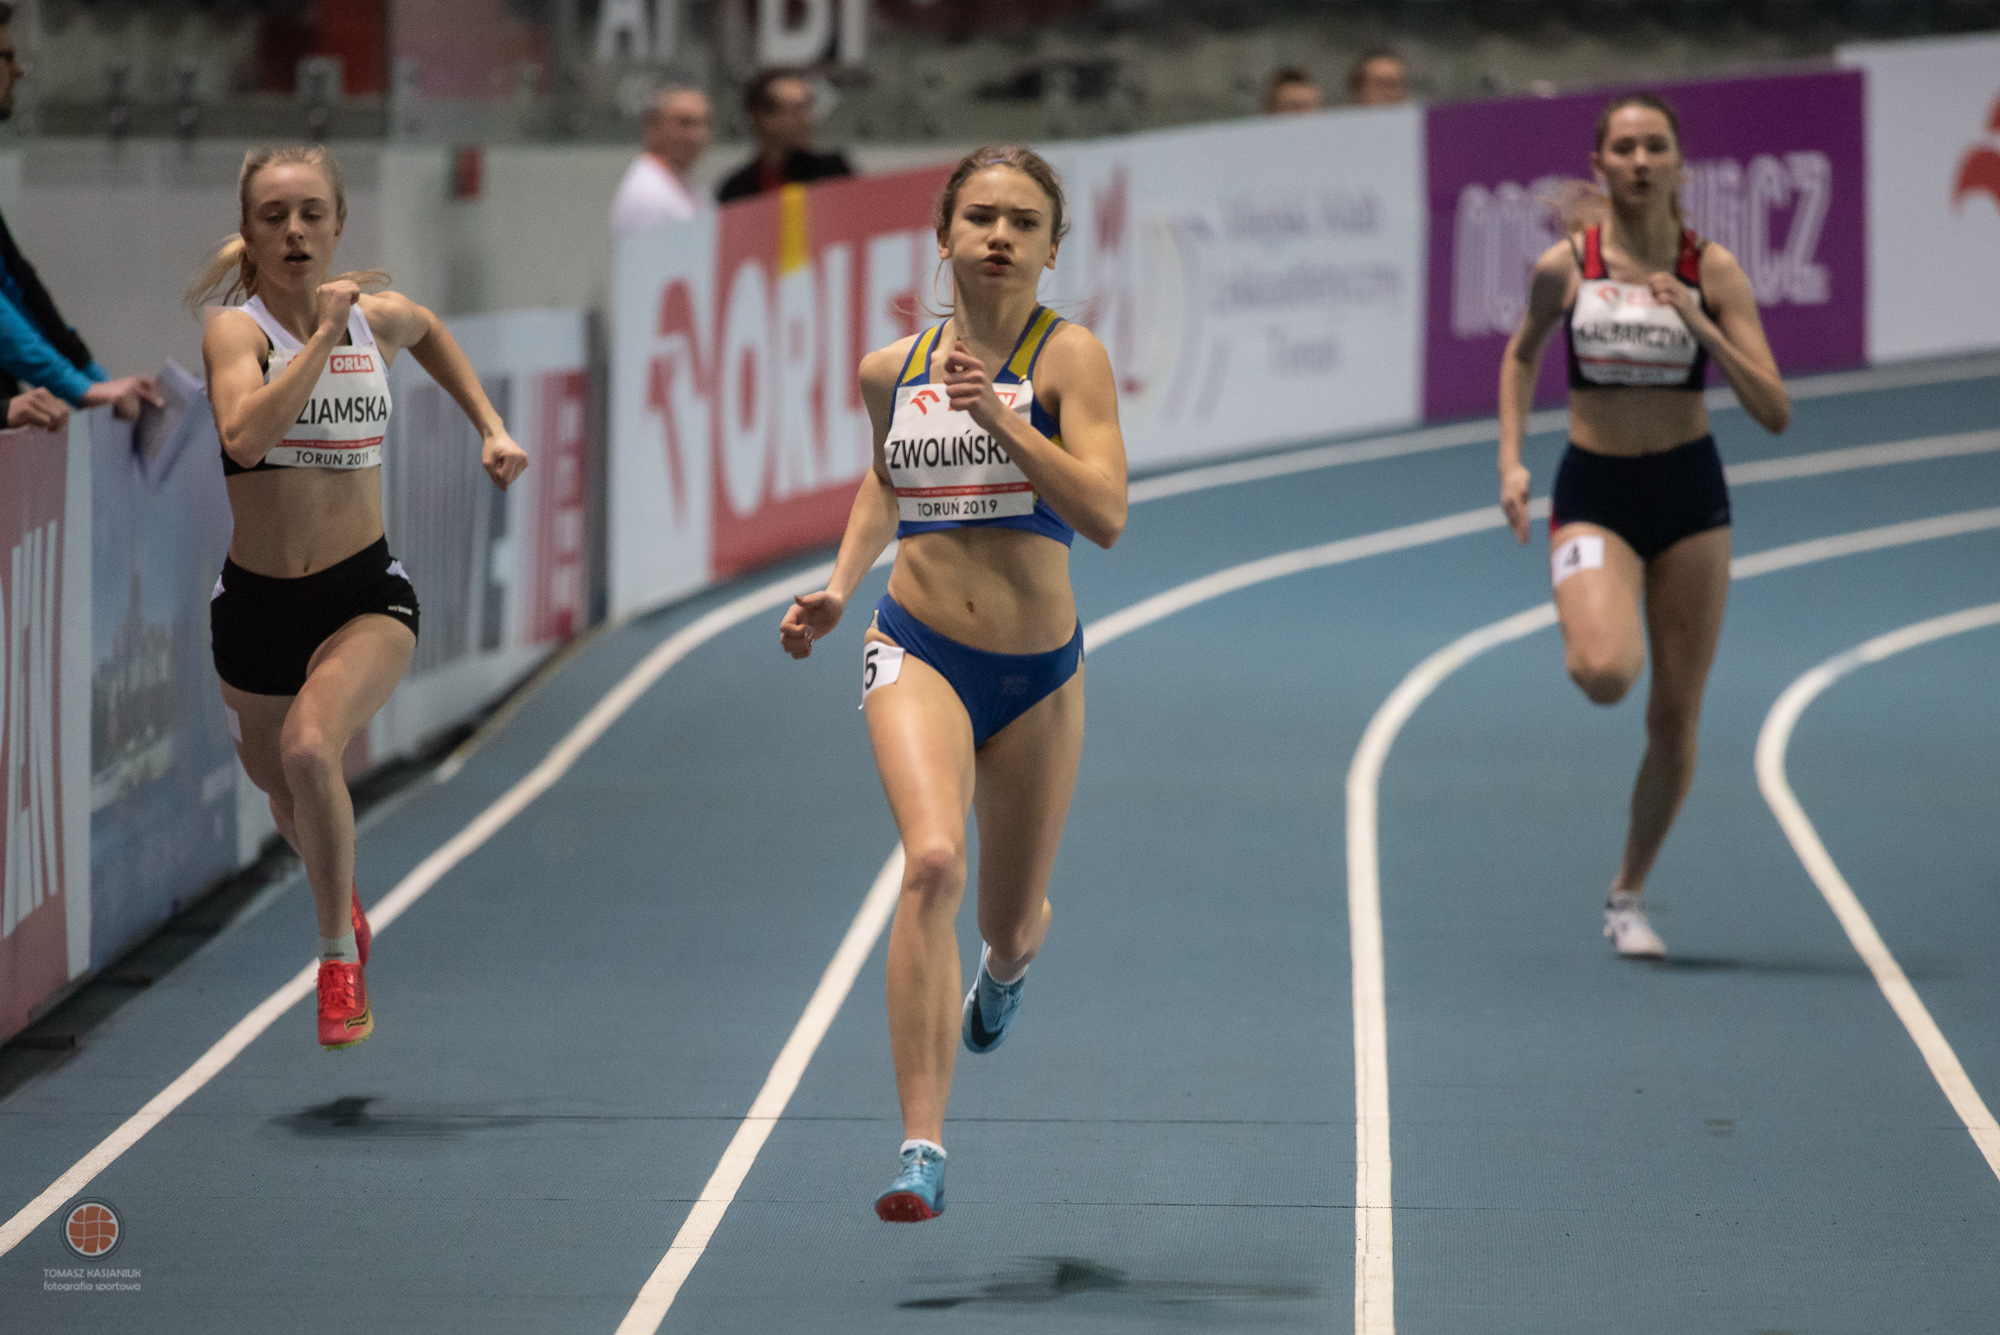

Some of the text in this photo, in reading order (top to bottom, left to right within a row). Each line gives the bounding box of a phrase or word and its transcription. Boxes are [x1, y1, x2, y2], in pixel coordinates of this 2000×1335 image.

[296, 396, 388, 425] ZIAMSKA
[296, 450, 343, 465] TORUŃ
[890, 429, 1010, 469] ZWOLIŃSK
[917, 498, 998, 516] TORUŃ 2019
[1565, 544, 1581, 567] 4
[864, 648, 879, 690] 5
